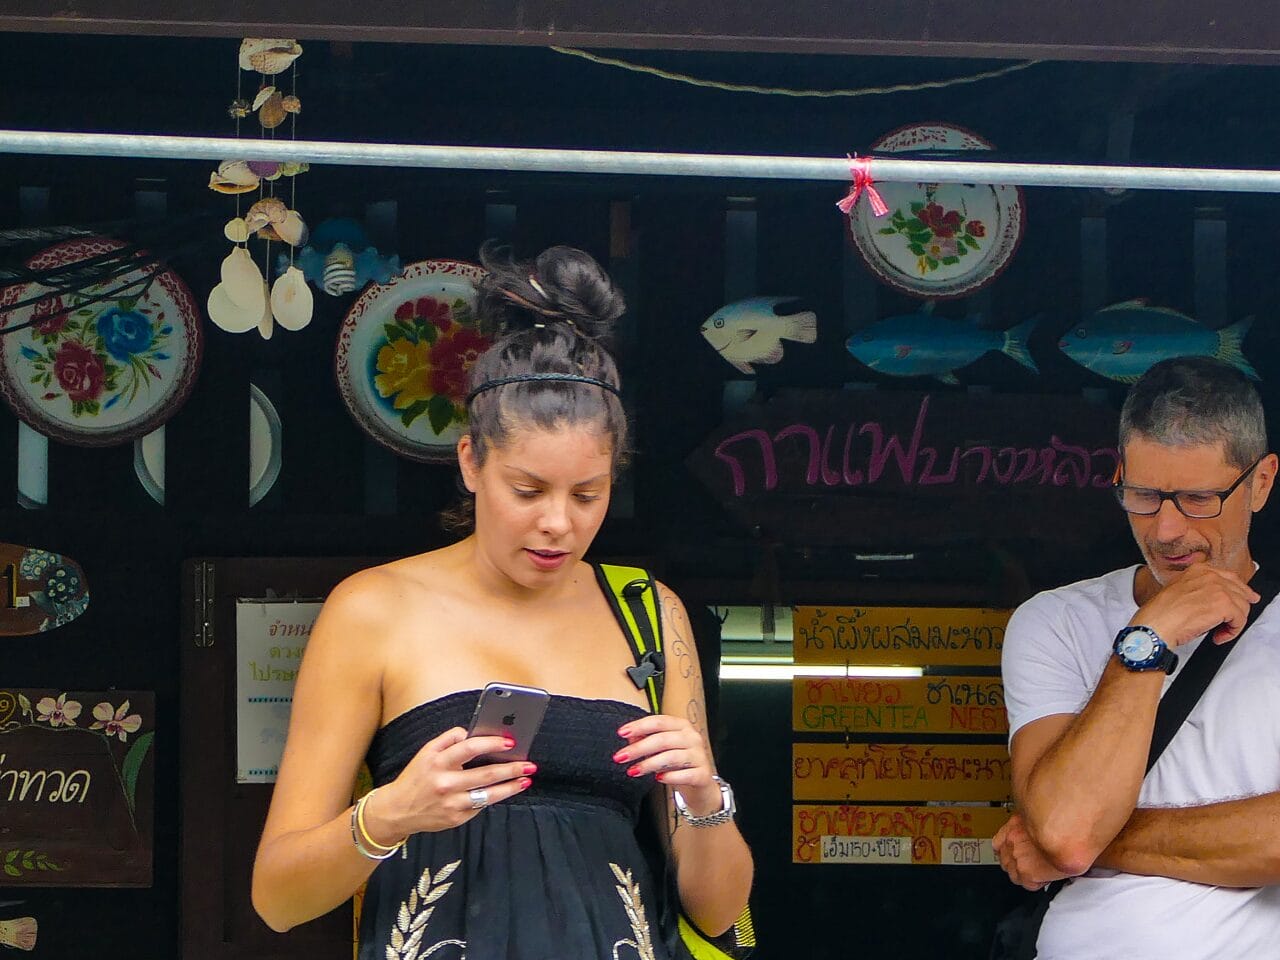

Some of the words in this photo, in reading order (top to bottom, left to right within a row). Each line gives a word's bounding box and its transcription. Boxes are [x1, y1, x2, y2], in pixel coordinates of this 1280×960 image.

[801, 705, 881, 729] GREEN
[882, 705, 929, 728] TEA
[0, 753, 91, 803] ่าทวด
